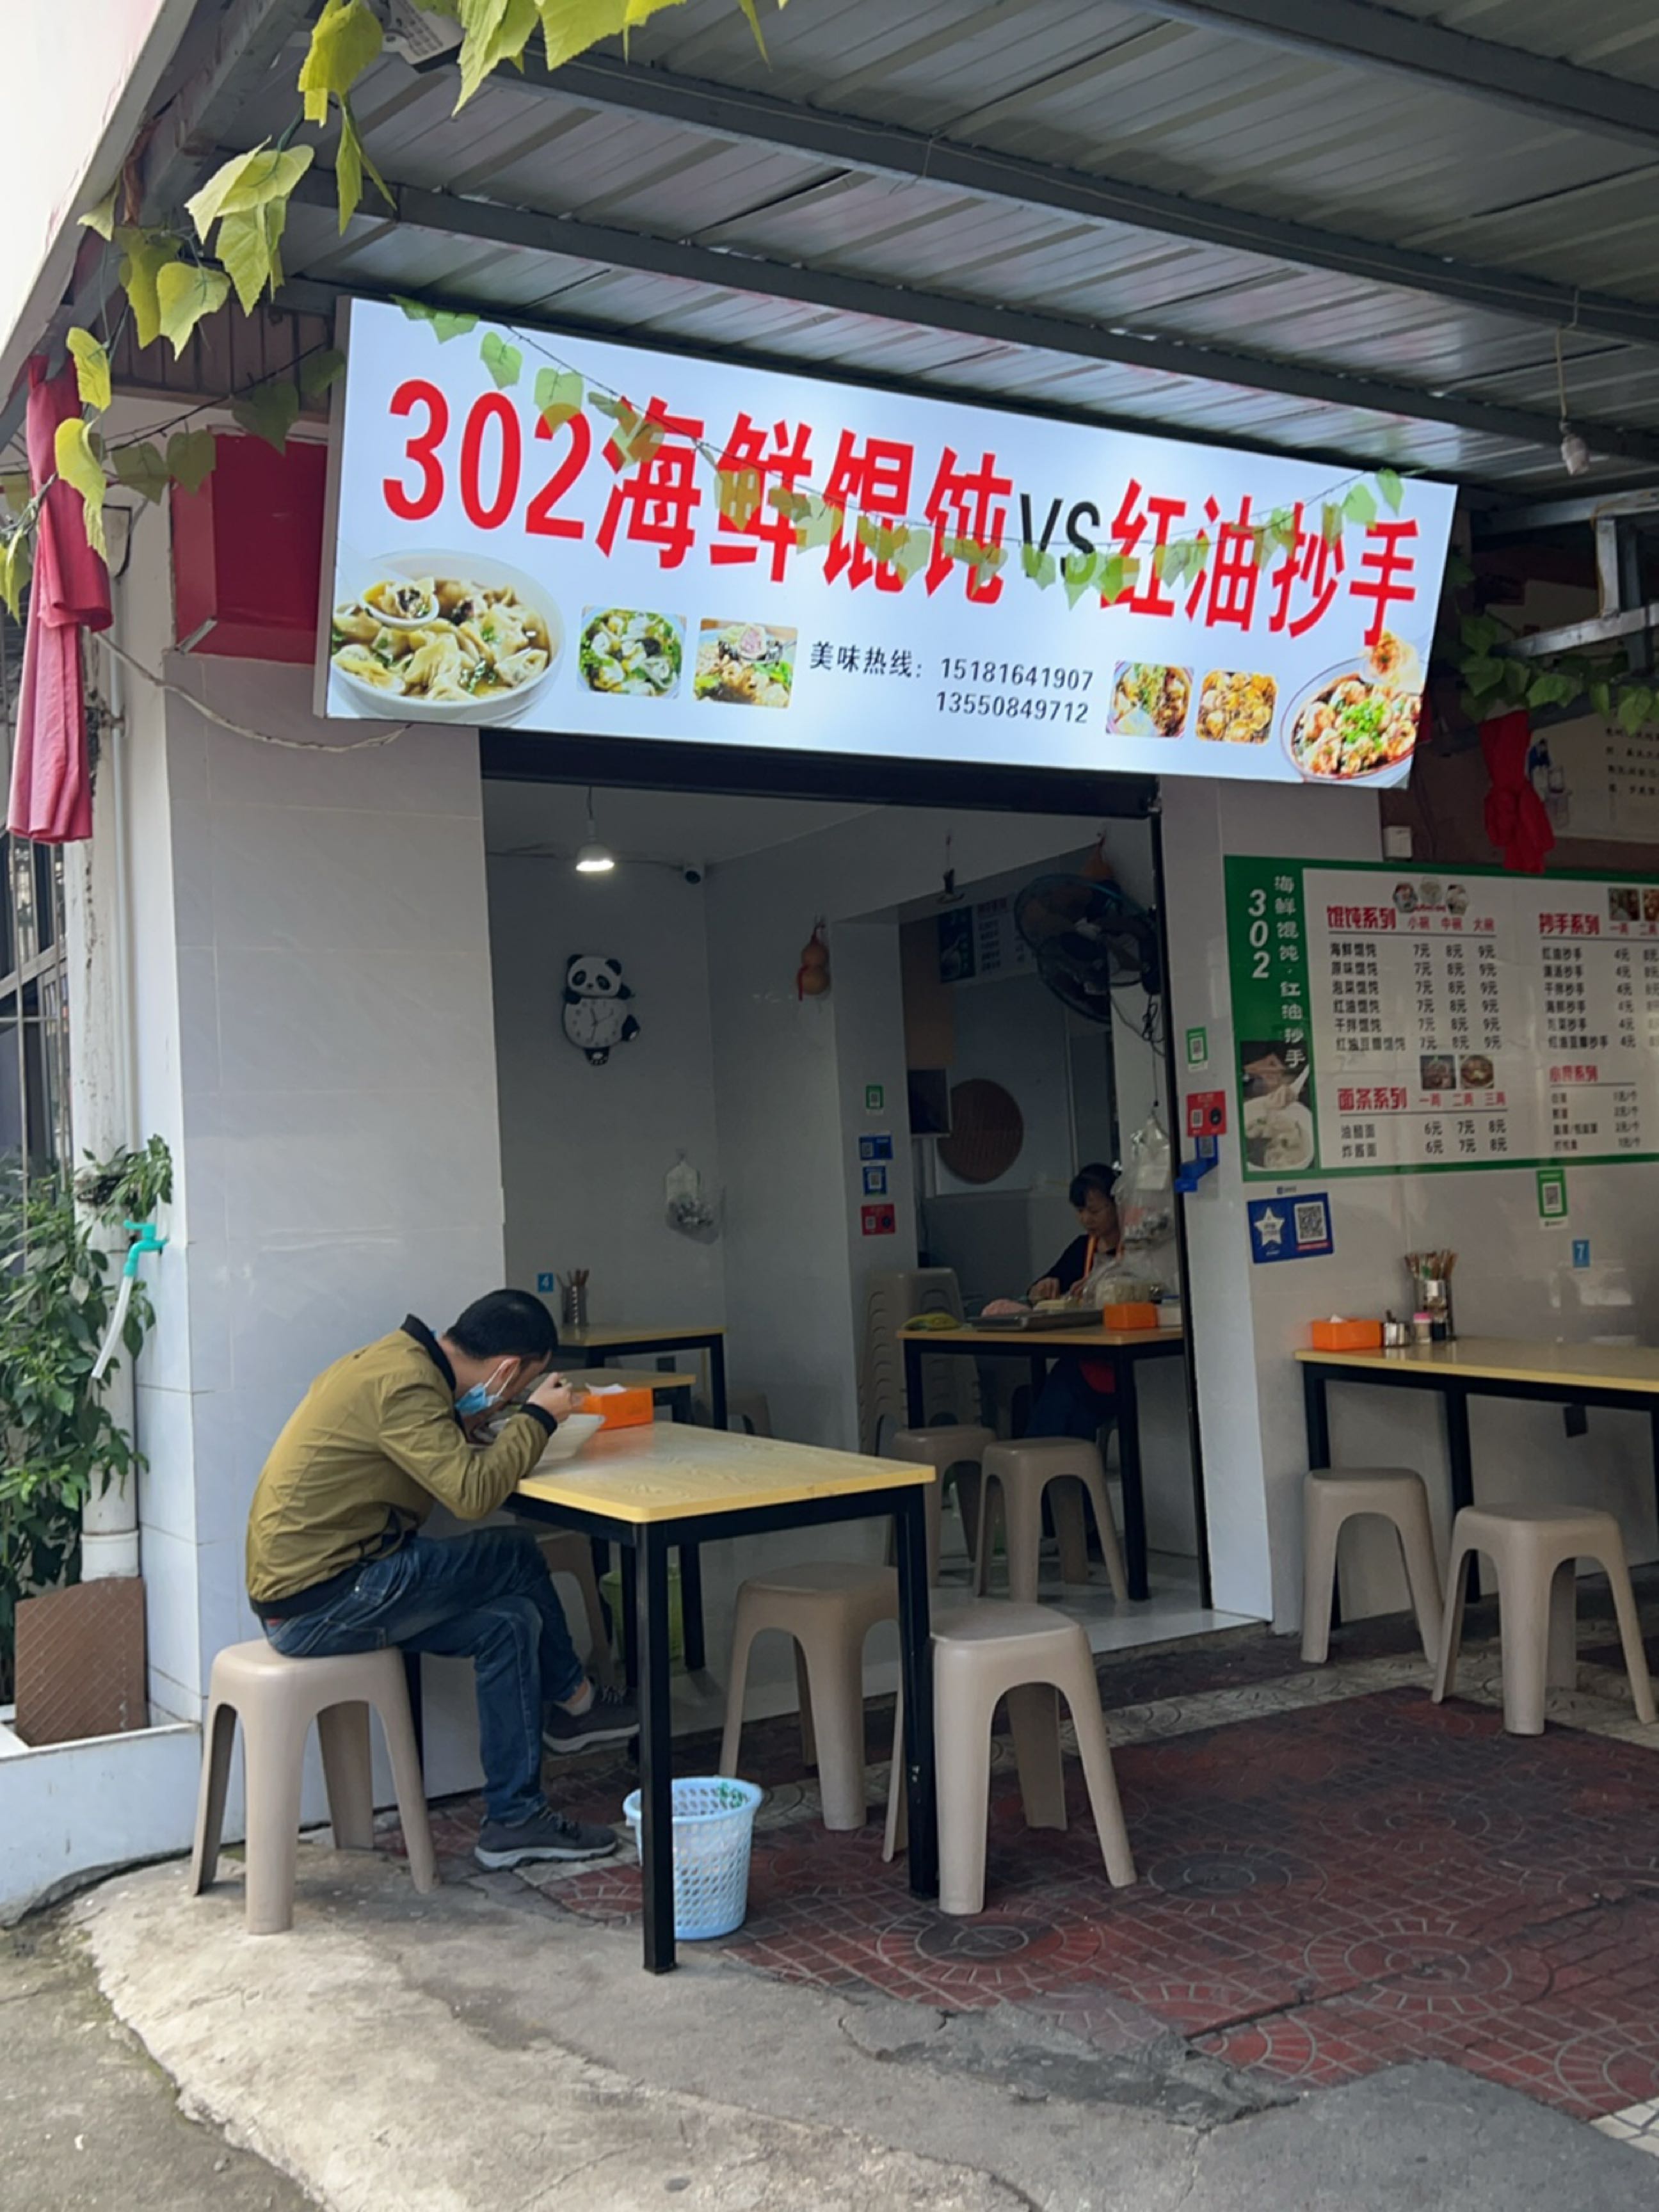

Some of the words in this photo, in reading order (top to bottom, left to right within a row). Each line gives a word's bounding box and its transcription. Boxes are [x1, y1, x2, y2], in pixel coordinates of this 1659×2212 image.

[941, 658, 1093, 691] 15181641907
[936, 691, 1089, 723] 13550849712
[1327, 906, 1396, 929] 馄饨系列
[1539, 912, 1599, 935] 抄手系列
[1248, 888, 1270, 978] 302
[1413, 943, 1431, 958] 7元
[1446, 943, 1463, 958] 8元
[1478, 944, 1496, 959] 9元
[1415, 961, 1432, 977] 7元
[1447, 962, 1464, 977] 8元
[1479, 962, 1497, 977] 9元
[1415, 980, 1434, 995] 7元
[1448, 980, 1466, 995] 8元
[1480, 981, 1498, 995] 9元
[1417, 998, 1434, 1013] 7元
[1450, 999, 1467, 1013] 8元
[1482, 999, 1499, 1013] 9元
[1418, 1017, 1436, 1032] 7元
[1451, 1017, 1469, 1032] 8元
[1483, 1017, 1500, 1032] 9元
[1338, 1087, 1407, 1110] 面条系列
[1424, 1121, 1443, 1135] 6元
[1457, 1120, 1475, 1134] 7元
[1488, 1119, 1507, 1134] 8元
[1425, 1139, 1443, 1154] 6元
[1459, 1139, 1476, 1153] 7元
[1490, 1137, 1508, 1152] 8元
[1576, 1244, 1585, 1261] 7
